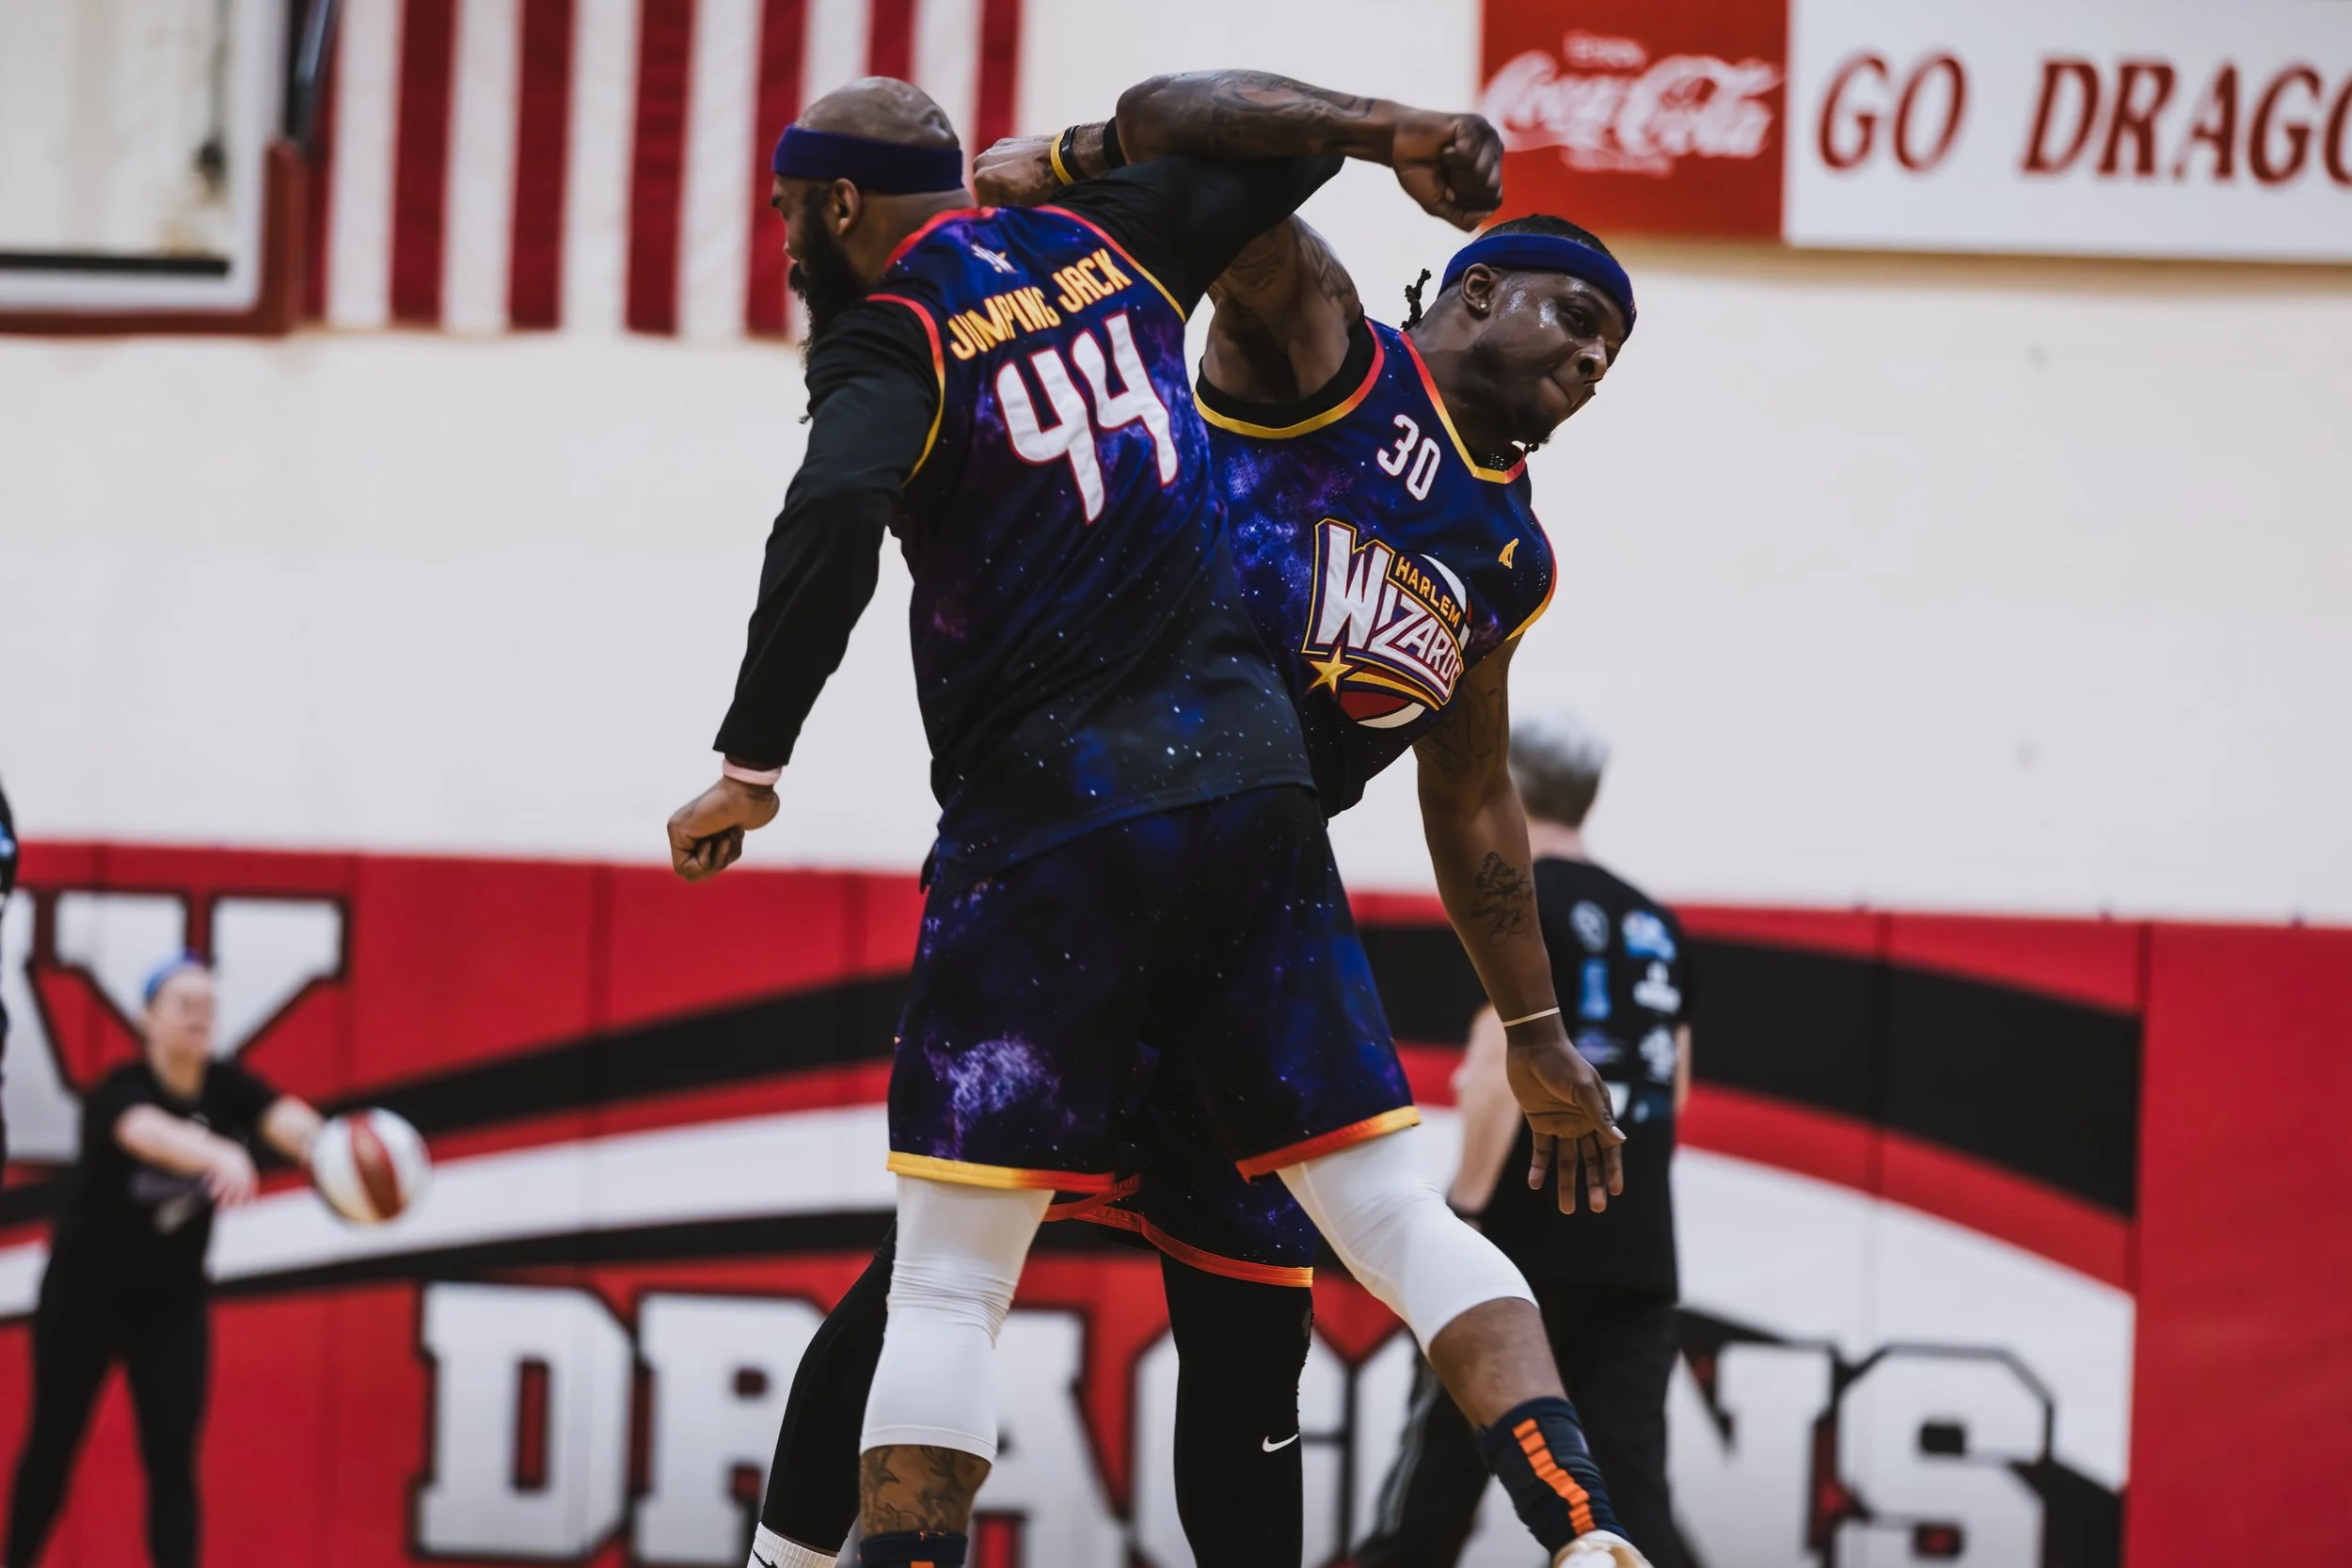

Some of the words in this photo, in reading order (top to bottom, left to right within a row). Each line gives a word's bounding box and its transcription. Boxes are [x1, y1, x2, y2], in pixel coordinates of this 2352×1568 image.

[1818, 53, 1966, 173] GO
[947, 286, 1061, 360] JUMPING
[1053, 247, 1132, 313] JACK
[995, 309, 1179, 526] 44
[1376, 413, 1441, 501] 30
[1394, 555, 1461, 628] HARLEM
